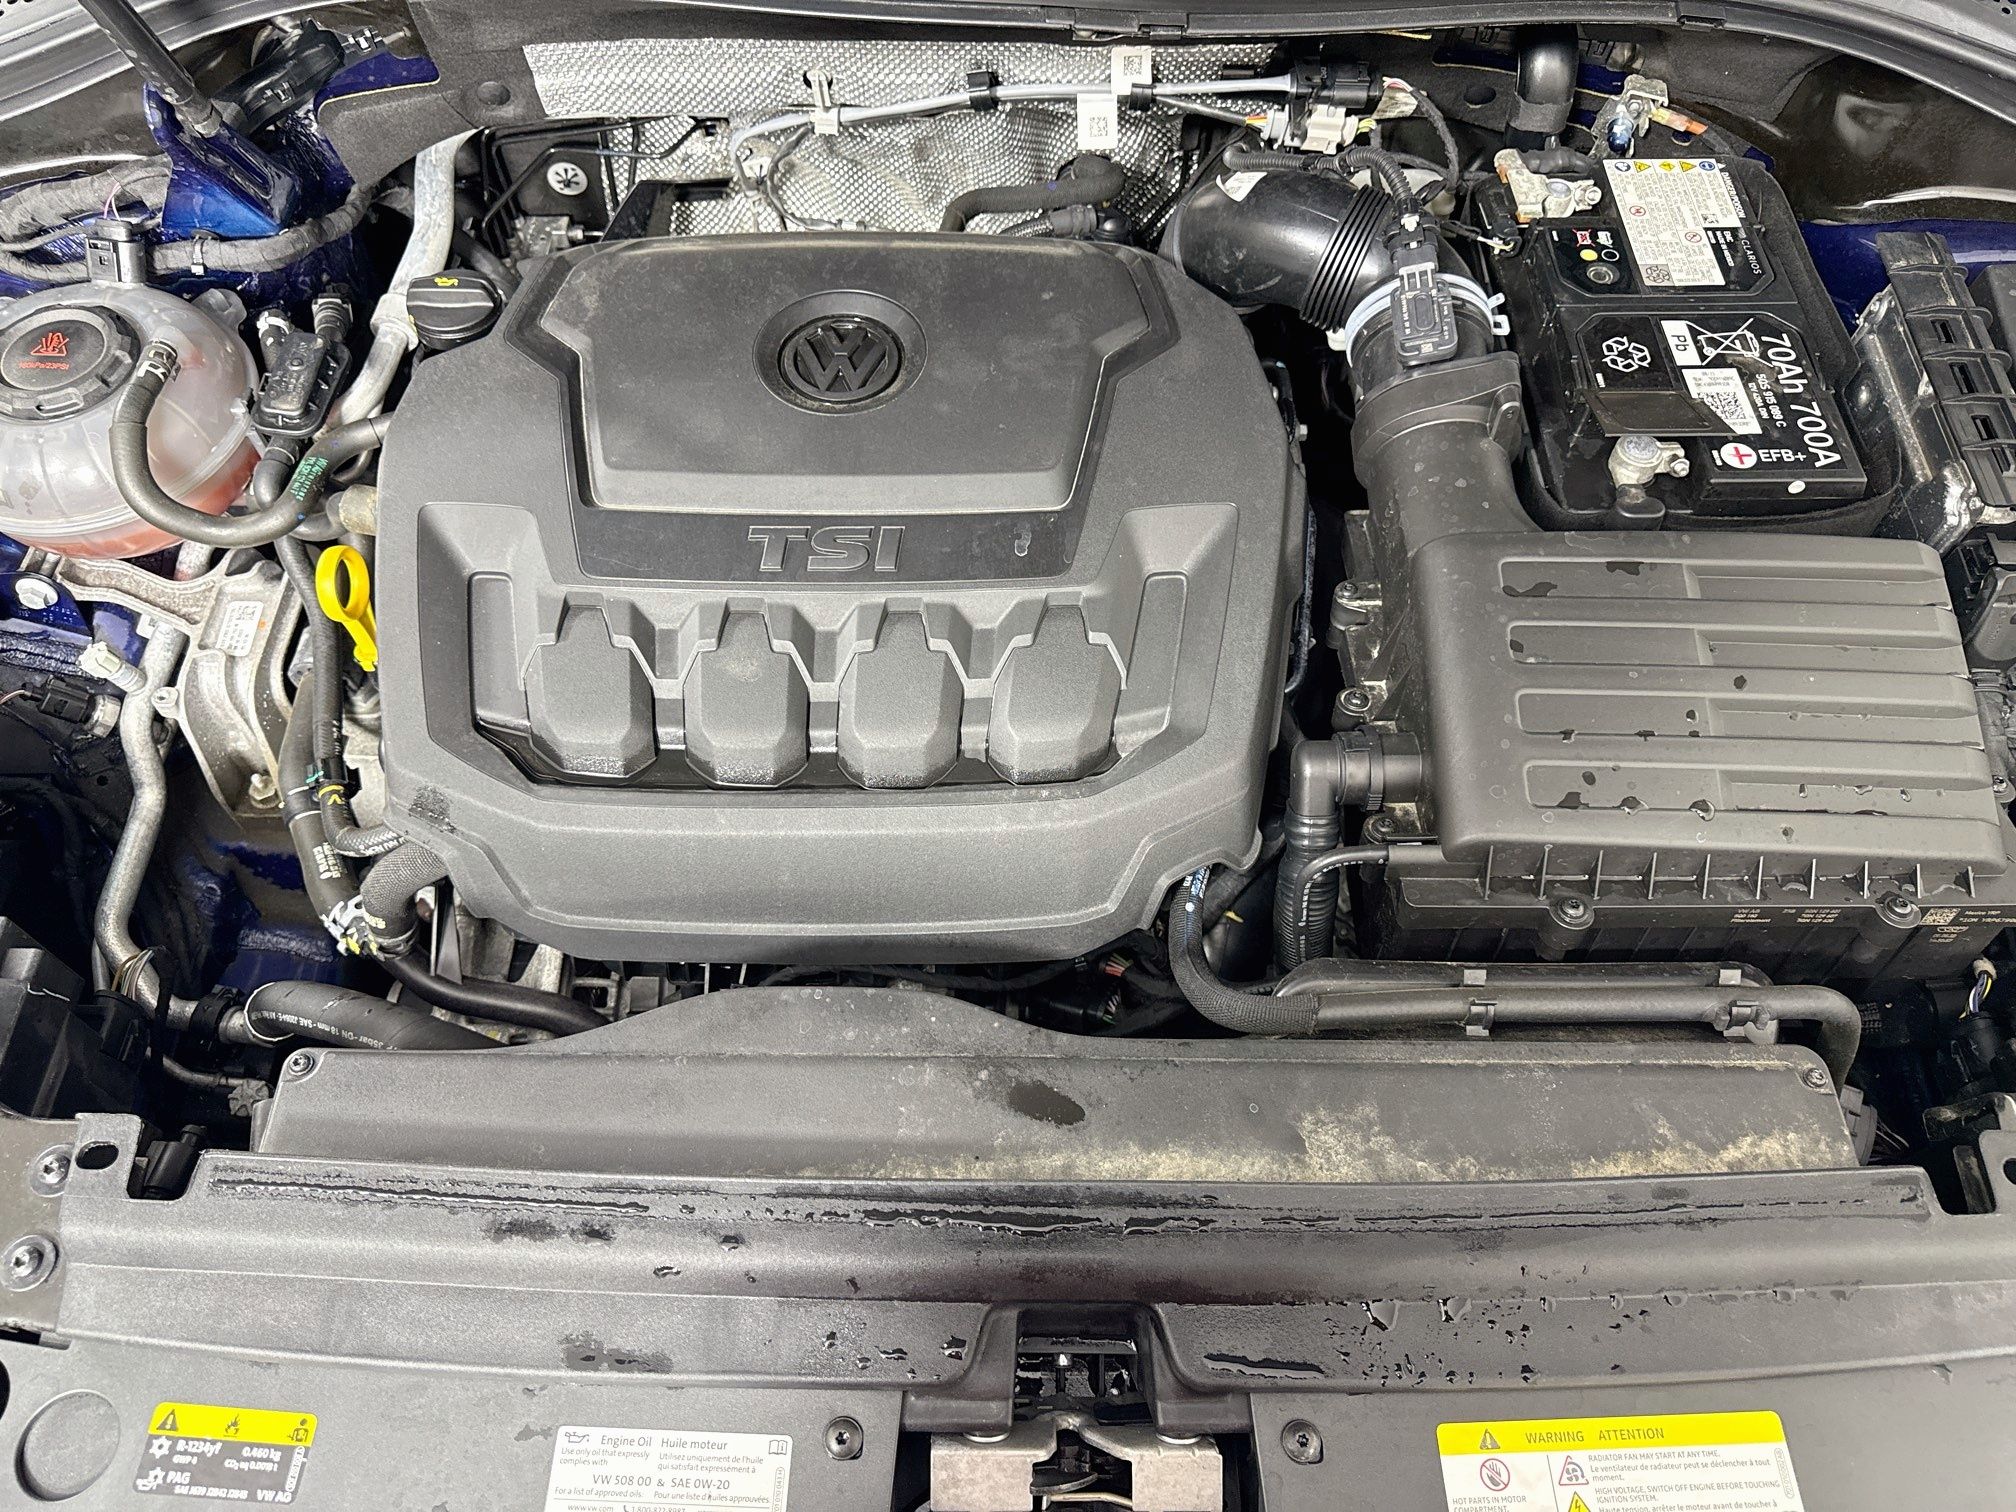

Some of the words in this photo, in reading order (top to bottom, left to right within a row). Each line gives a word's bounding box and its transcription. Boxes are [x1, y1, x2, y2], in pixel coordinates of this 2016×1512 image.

[1741, 239, 1762, 275] CLARIOS
[1671, 334, 1687, 351] Pb
[793, 321, 894, 397] VW
[1761, 333, 1808, 394] 70Ah
[1790, 401, 1842, 468] 700A
[1763, 393, 1778, 408] 915
[1758, 448, 1807, 462] EFB+
[748, 525, 906, 572] TSI
[299, 1017, 313, 1028] SAE
[359, 1036, 384, 1049] 35bar
[600, 1435, 635, 1448] Engine
[637, 1436, 652, 1447] Oil
[1525, 1430, 1585, 1444] WARNING
[1598, 1428, 1665, 1441] ATTENTION
[661, 1437, 688, 1449] Huile
[690, 1440, 728, 1450] moteur
[176, 1439, 223, 1458] R-1234yf
[269, 1447, 282, 1462] kg
[561, 1447, 575, 1455] Use
[576, 1447, 591, 1457] only
[592, 1448, 601, 1456] oil
[602, 1448, 616, 1457] that
[617, 1450, 650, 1461] expressly
[1588, 1452, 1623, 1462] RADIATOR
[1624, 1452, 1638, 1461] FAN
[1639, 1451, 1654, 1460] MAY
[1655, 1450, 1677, 1460] START
[1677, 1450, 1686, 1459] AT
[1686, 1450, 1701, 1459] ANY
[559, 1458, 591, 1467] complies
[592, 1458, 609, 1466] with
[659, 1452, 686, 1461] Utilisez
[686, 1454, 730, 1464] uniquement
[731, 1455, 741, 1463] de
[742, 1455, 764, 1464] l'huile
[657, 1464, 670, 1472] qui
[670, 1463, 699, 1472] satisfait
[1590, 1464, 1599, 1473] Le
[1600, 1462, 1639, 1472] ventilateur
[1639, 1461, 1649, 1471] de
[1650, 1460, 1682, 1470] radiateur
[1683, 1461, 1700, 1472] peut
[1701, 1461, 1709, 1469] se
[1710, 1458, 1748, 1468] déclencher
[1755, 1458, 1770, 1467] tout
[166, 1471, 191, 1484] PAG
[592, 1474, 612, 1485] VW
[614, 1475, 635, 1486] 508
[637, 1476, 652, 1486] 00
[657, 1478, 665, 1487] &
[671, 1477, 691, 1488] SAE
[693, 1478, 730, 1490] 0W-20
[1592, 1473, 1625, 1482] moment.
[554, 1486, 567, 1495] For
[573, 1487, 585, 1495] list
[585, 1487, 594, 1496] of
[594, 1488, 628, 1498] approved
[1595, 1487, 1613, 1495] HIGH
[1646, 1484, 1673, 1493] SWITCH
[1675, 1484, 1688, 1492] OFF
[1690, 1483, 1716, 1491] ENGINE
[1716, 1481, 1745, 1490] BEFORE
[1745, 1480, 1780, 1489] TOUCHING
[256, 1489, 275, 1502] VW
[275, 1491, 292, 1503] AG
[653, 1490, 670, 1500] Pour
[671, 1492, 685, 1500] une
[686, 1491, 701, 1501] liste
[1452, 1497, 1467, 1505] HOT
[1468, 1496, 1491, 1504] PARTS
[1491, 1496, 1500, 1504] IN
[1501, 1495, 1527, 1503] MOTOR
[1596, 1495, 1628, 1504] IGNITION
[567, 1504, 614, 1512] www.vw.com
[1652, 1503, 1676, 1512] arrêter
[1677, 1503, 1684, 1512] le
[1685, 1502, 1711, 1511] moteur
[1713, 1502, 1733, 1510] avant
[1734, 1501, 1743, 1509] de
[1744, 1499, 1771, 1509] toucher
